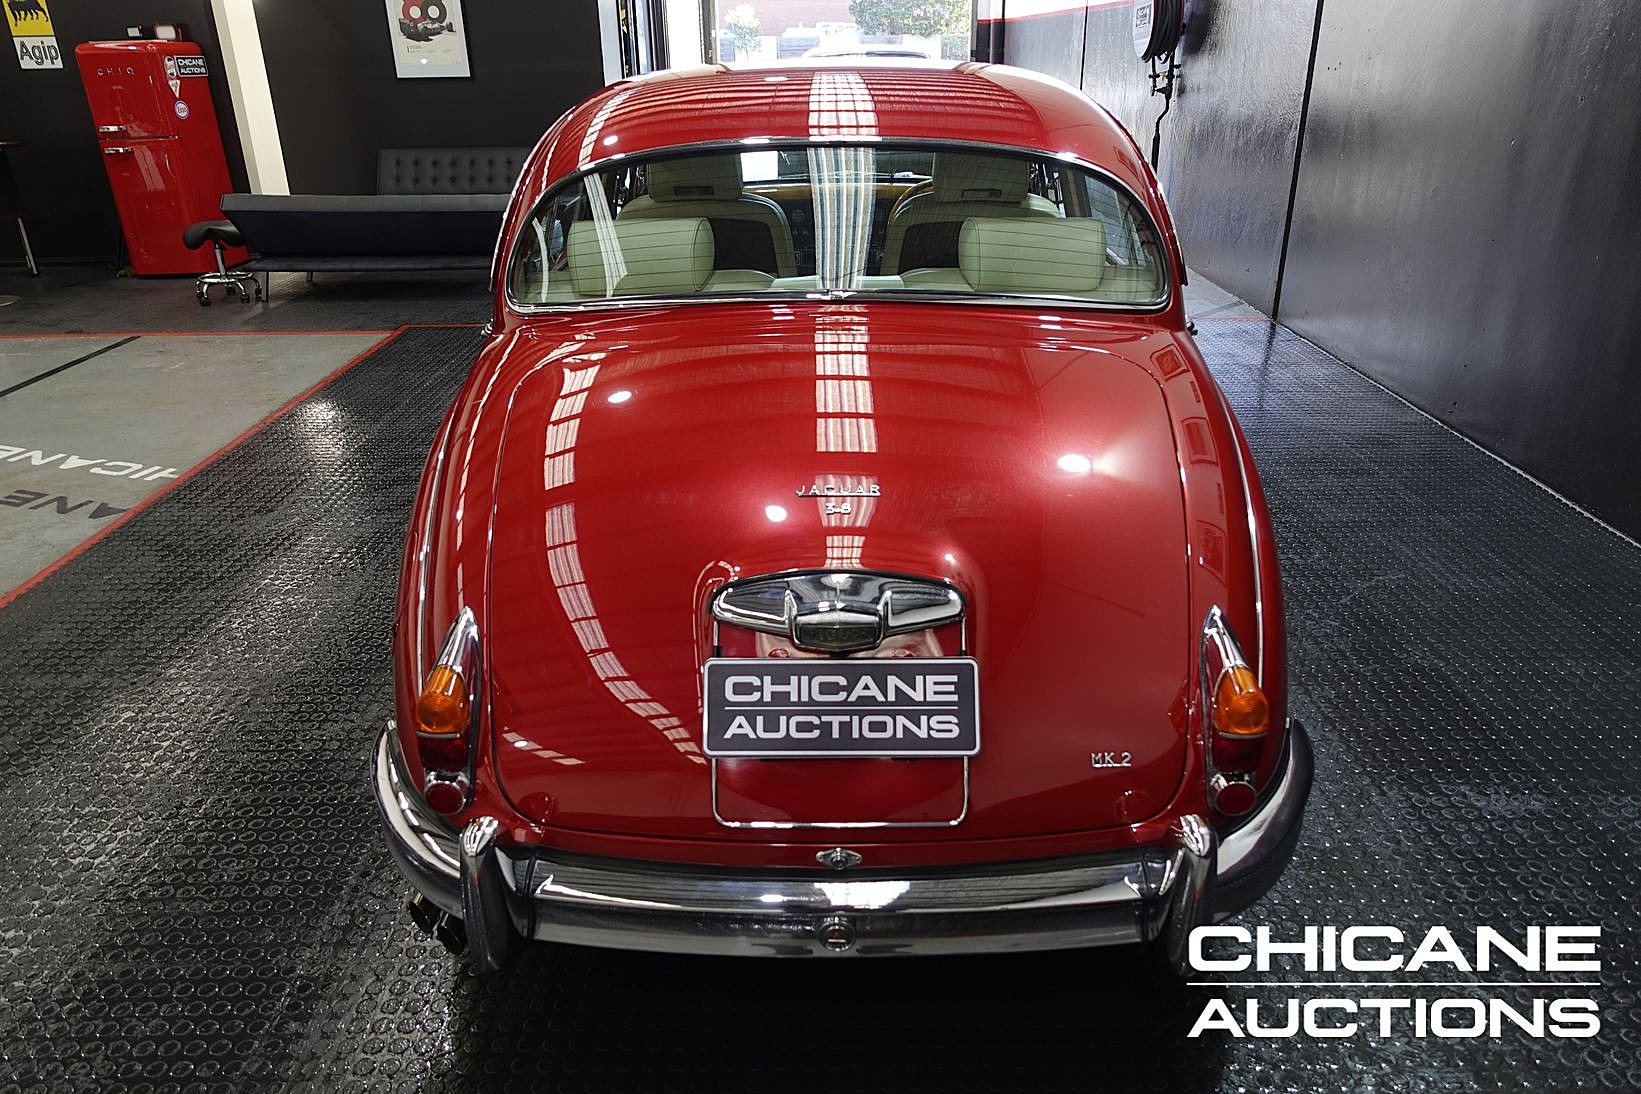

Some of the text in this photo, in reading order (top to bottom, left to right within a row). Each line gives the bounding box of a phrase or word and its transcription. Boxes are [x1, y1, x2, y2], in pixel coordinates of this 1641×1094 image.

[19, 40, 60, 66] Agip
[795, 484, 881, 496] JAGUAR
[724, 675, 958, 702] CHICANE
[723, 715, 960, 739] AUCTIONS
